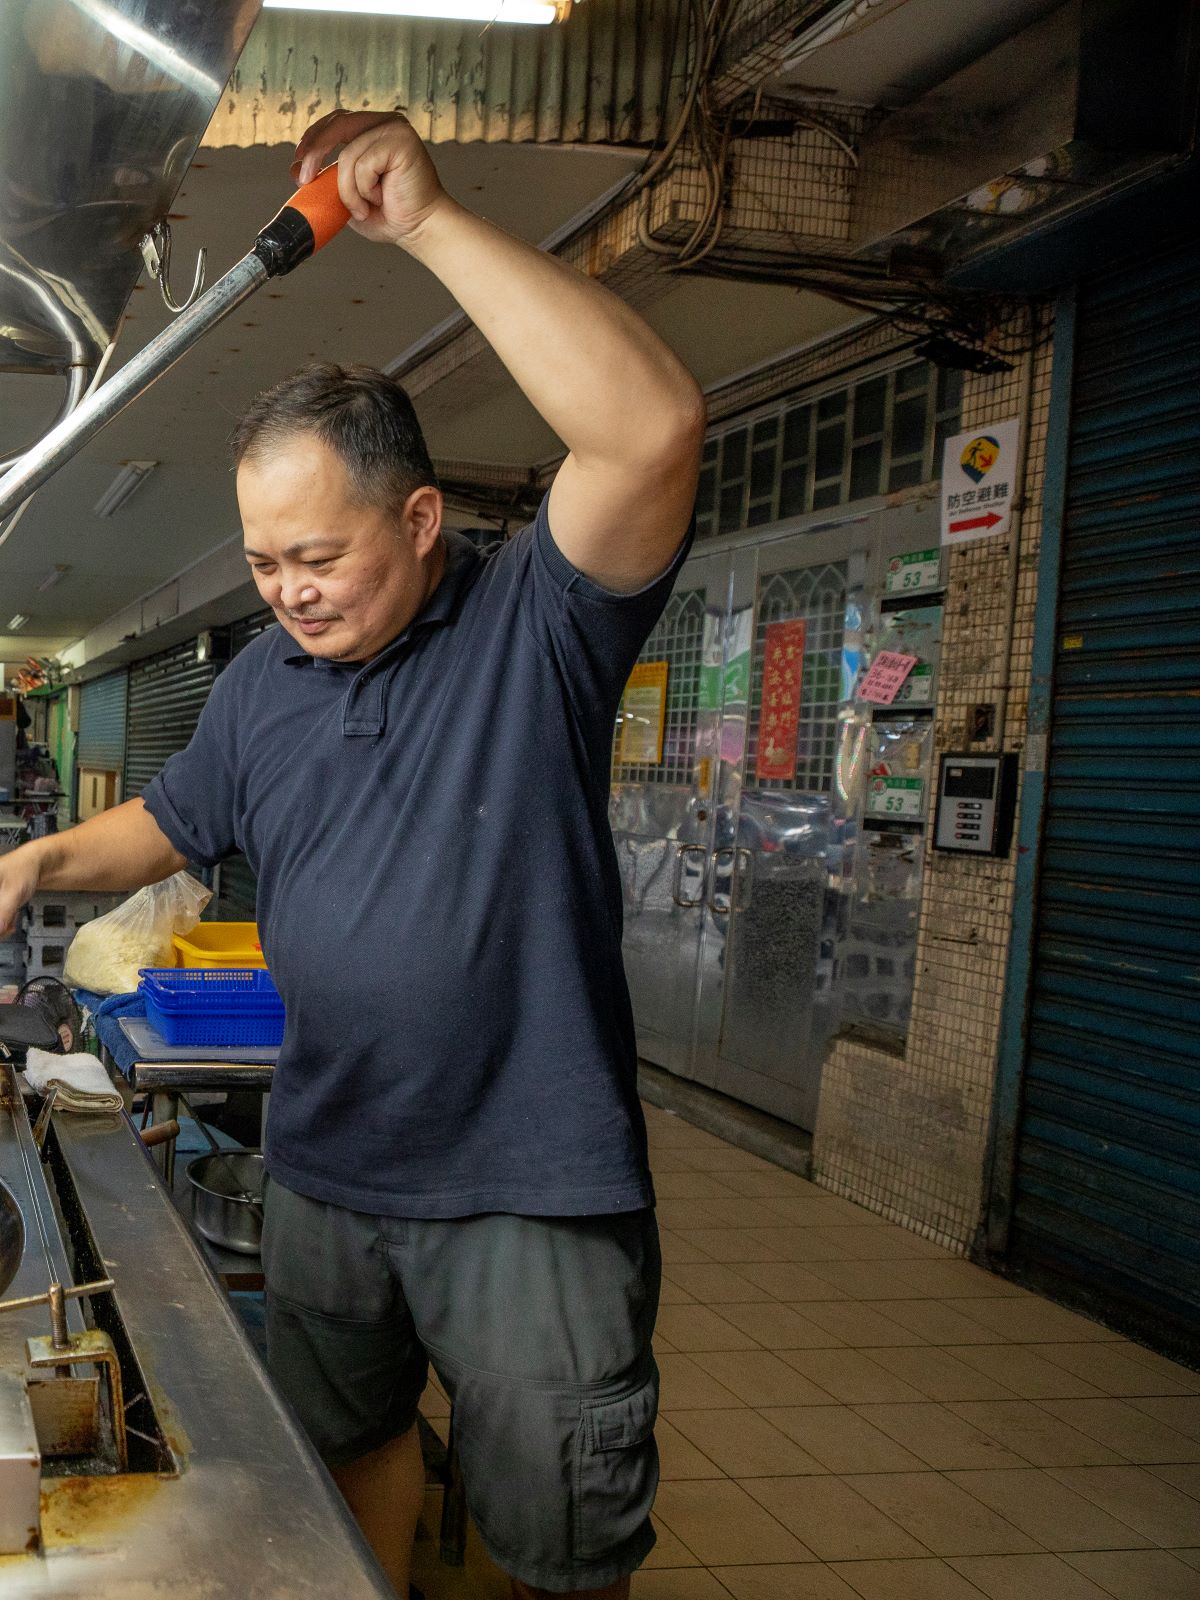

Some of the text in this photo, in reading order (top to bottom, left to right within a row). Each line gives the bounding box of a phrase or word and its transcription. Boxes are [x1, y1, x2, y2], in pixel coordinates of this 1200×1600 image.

[947, 482, 1009, 510] 防空避難
[903, 571, 922, 588] 53
[886, 796, 905, 812] 53
